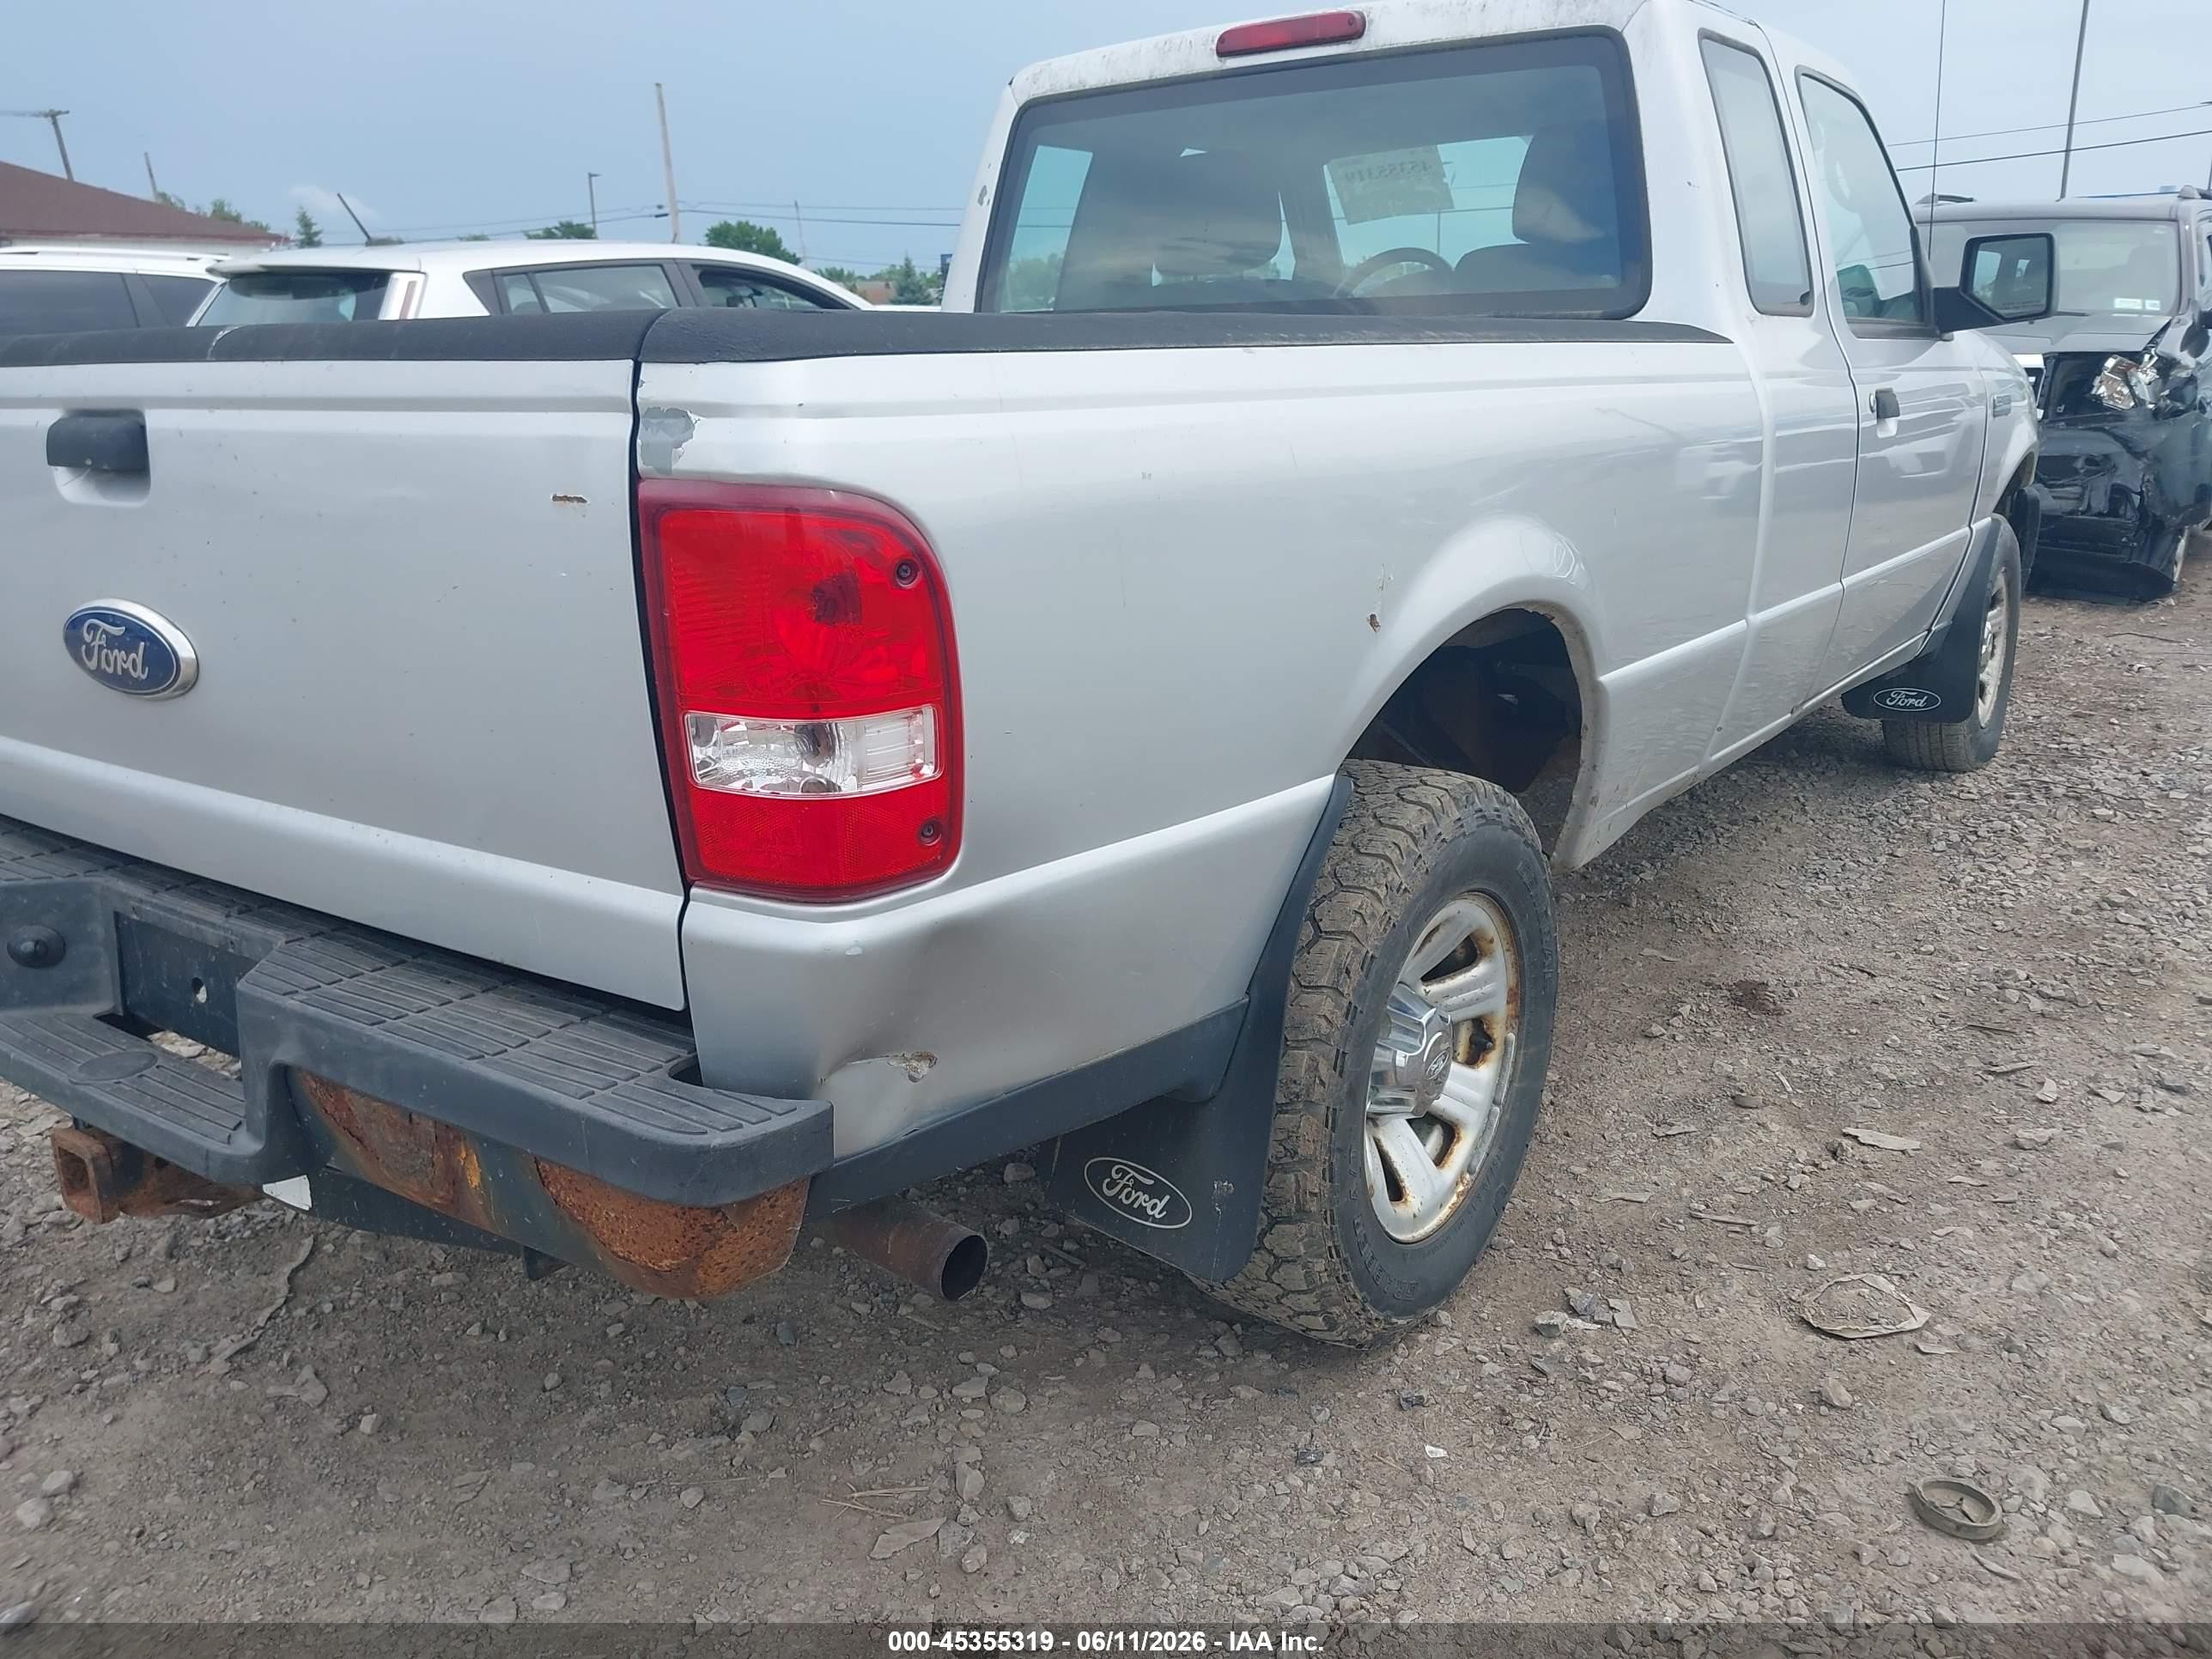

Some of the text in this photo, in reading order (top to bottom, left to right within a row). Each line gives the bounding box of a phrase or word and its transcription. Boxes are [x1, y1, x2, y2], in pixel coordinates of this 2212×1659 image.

[82, 618, 149, 680] Ford
[1886, 691, 1928, 708] Ford
[1102, 1164, 1170, 1218] Ford
